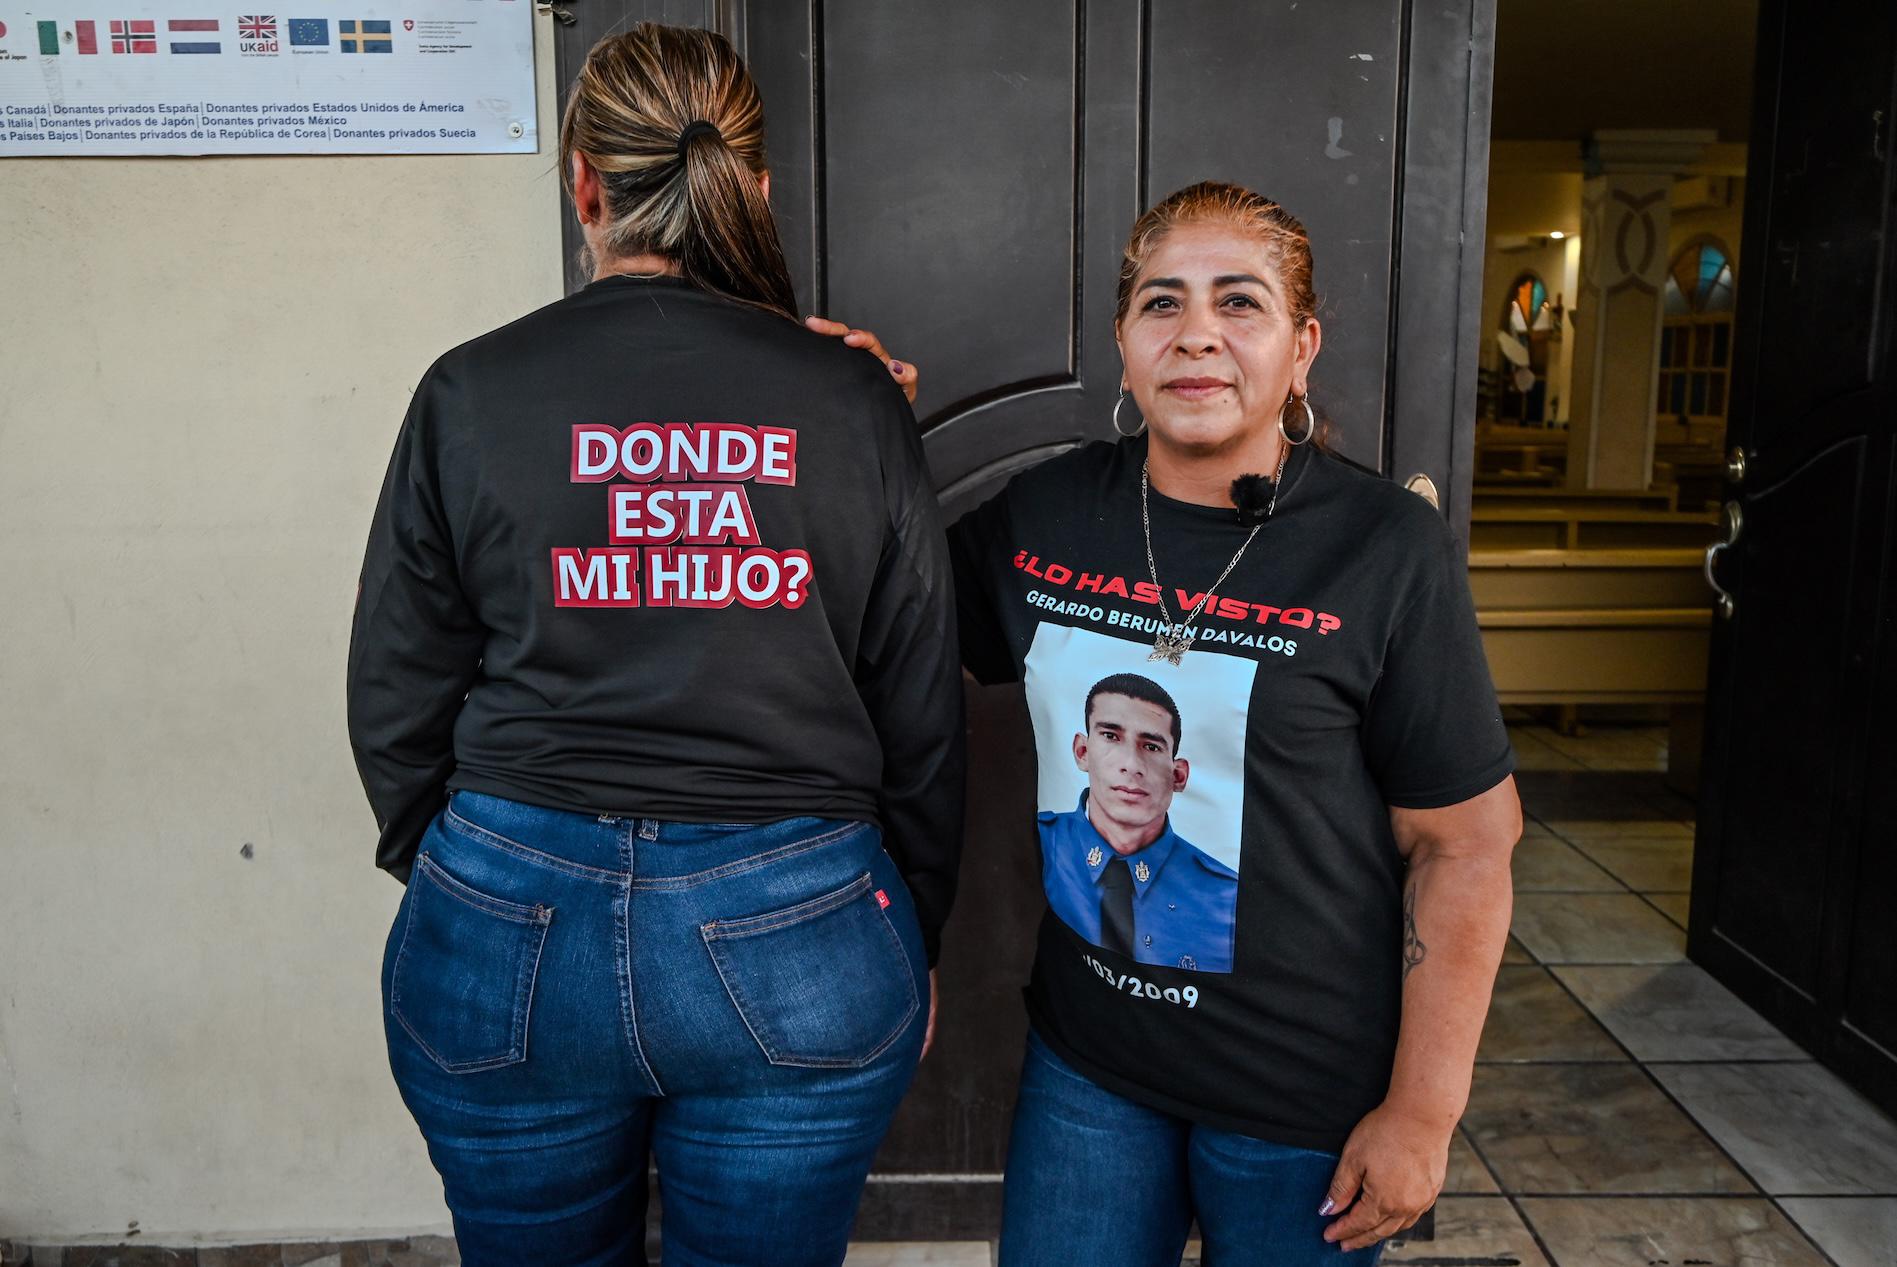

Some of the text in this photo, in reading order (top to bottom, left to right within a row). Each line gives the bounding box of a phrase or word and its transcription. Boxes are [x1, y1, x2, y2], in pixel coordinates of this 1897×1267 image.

[6, 104, 47, 115] Canadá
[53, 104, 105, 114] Donantes
[108, 104, 155, 116] privados
[158, 103, 199, 115] España
[206, 103, 258, 113] Donantes
[262, 102, 310, 114] privados
[313, 102, 357, 112] Estados
[360, 103, 400, 112] Unidos
[402, 102, 416, 112] de
[8, 118, 33, 128] Italia
[40, 118, 91, 127] Donantes
[95, 117, 141, 129] privados
[145, 117, 158, 126] de
[161, 116, 195, 128] Japón
[202, 116, 254, 126] Donantes
[257, 115, 305, 127] privados
[308, 115, 347, 125] México
[48, 130, 79, 143] Bajos
[85, 130, 137, 140] Donantes
[140, 129, 187, 141] privados
[190, 129, 204, 139] de
[207, 129, 216, 139] la
[219, 129, 274, 140] República
[277, 128, 291, 138] de
[294, 128, 327, 138] Corea
[333, 128, 385, 138] Donantes
[389, 128, 436, 140] privados
[439, 127, 476, 138] Suecia
[577, 429, 790, 478] DONDE
[614, 490, 751, 538] ESTA
[557, 554, 810, 602] MI HIJO?
[1013, 550, 1343, 636] ¿LO HAS VISTO?
[1026, 590, 1298, 657] GERARDO BERUMEN DAVALOS
